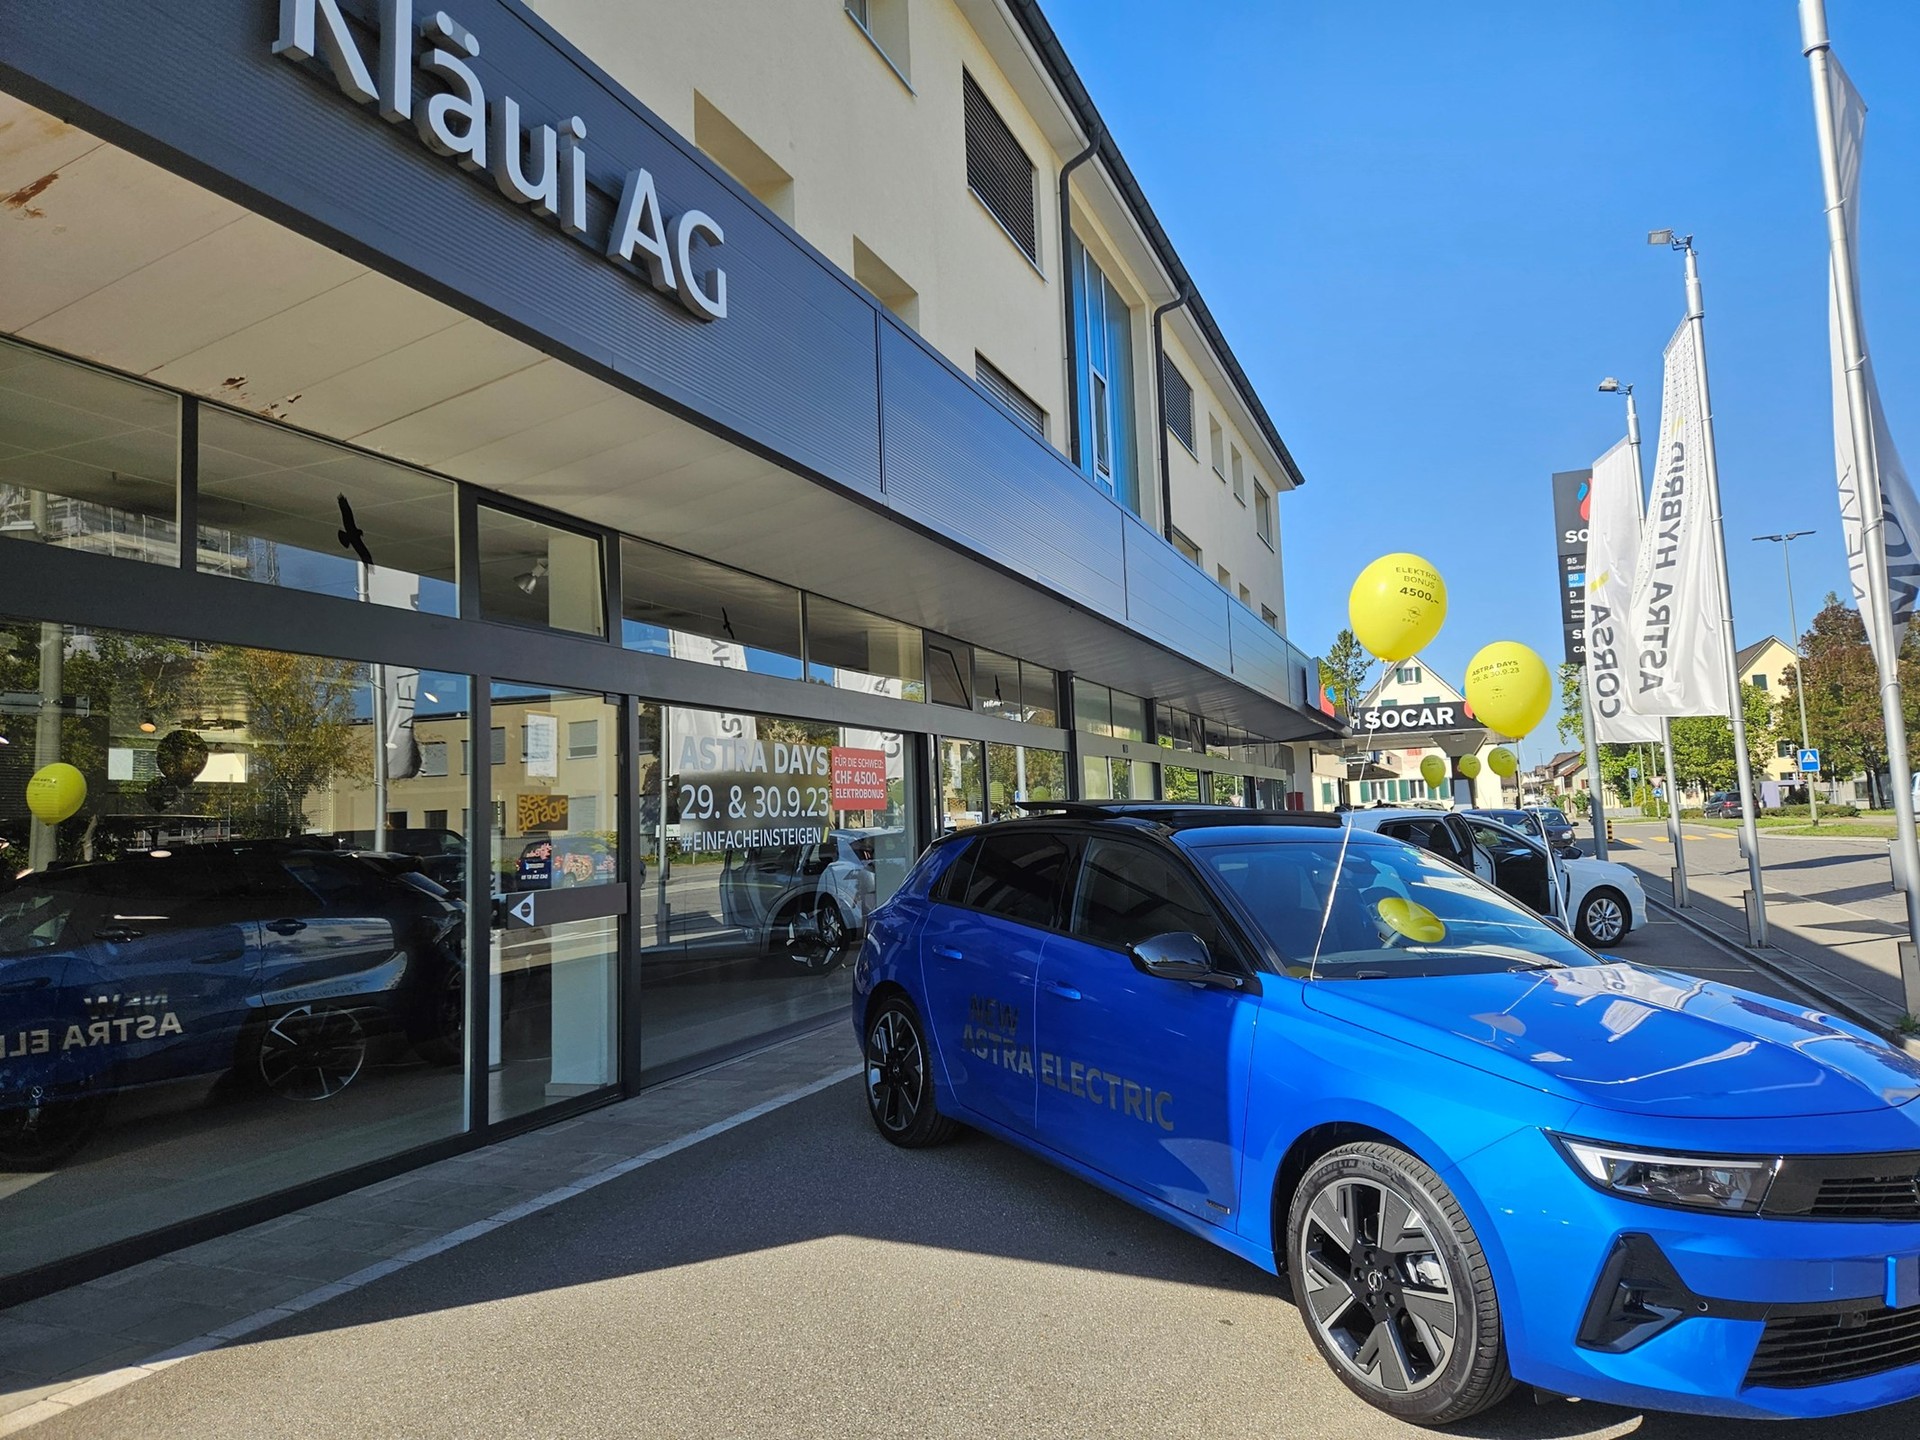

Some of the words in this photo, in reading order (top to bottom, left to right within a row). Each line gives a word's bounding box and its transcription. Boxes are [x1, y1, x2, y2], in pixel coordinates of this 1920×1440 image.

[607, 167, 728, 320] AG
[1396, 566, 1440, 581] ELEKTRO-
[1404, 575, 1435, 589] BONUS
[1472, 664, 1494, 676] ASTRA
[1496, 660, 1518, 668] DAYS
[1364, 707, 1455, 729] SOCAR
[680, 736, 768, 774] ASTRA
[774, 743, 829, 776] DAYS
[848, 759, 857, 768] DIE
[834, 770, 852, 784] CHF
[680, 784, 721, 820] 29.
[728, 785, 747, 819] &
[753, 786, 829, 818] 30.9.23
[835, 788, 885, 799] ELEKTROBONUS
[968, 993, 1020, 1037] NEW
[963, 1024, 1035, 1078] ASTRA
[1041, 1051, 1175, 1132] ELECTRIC
